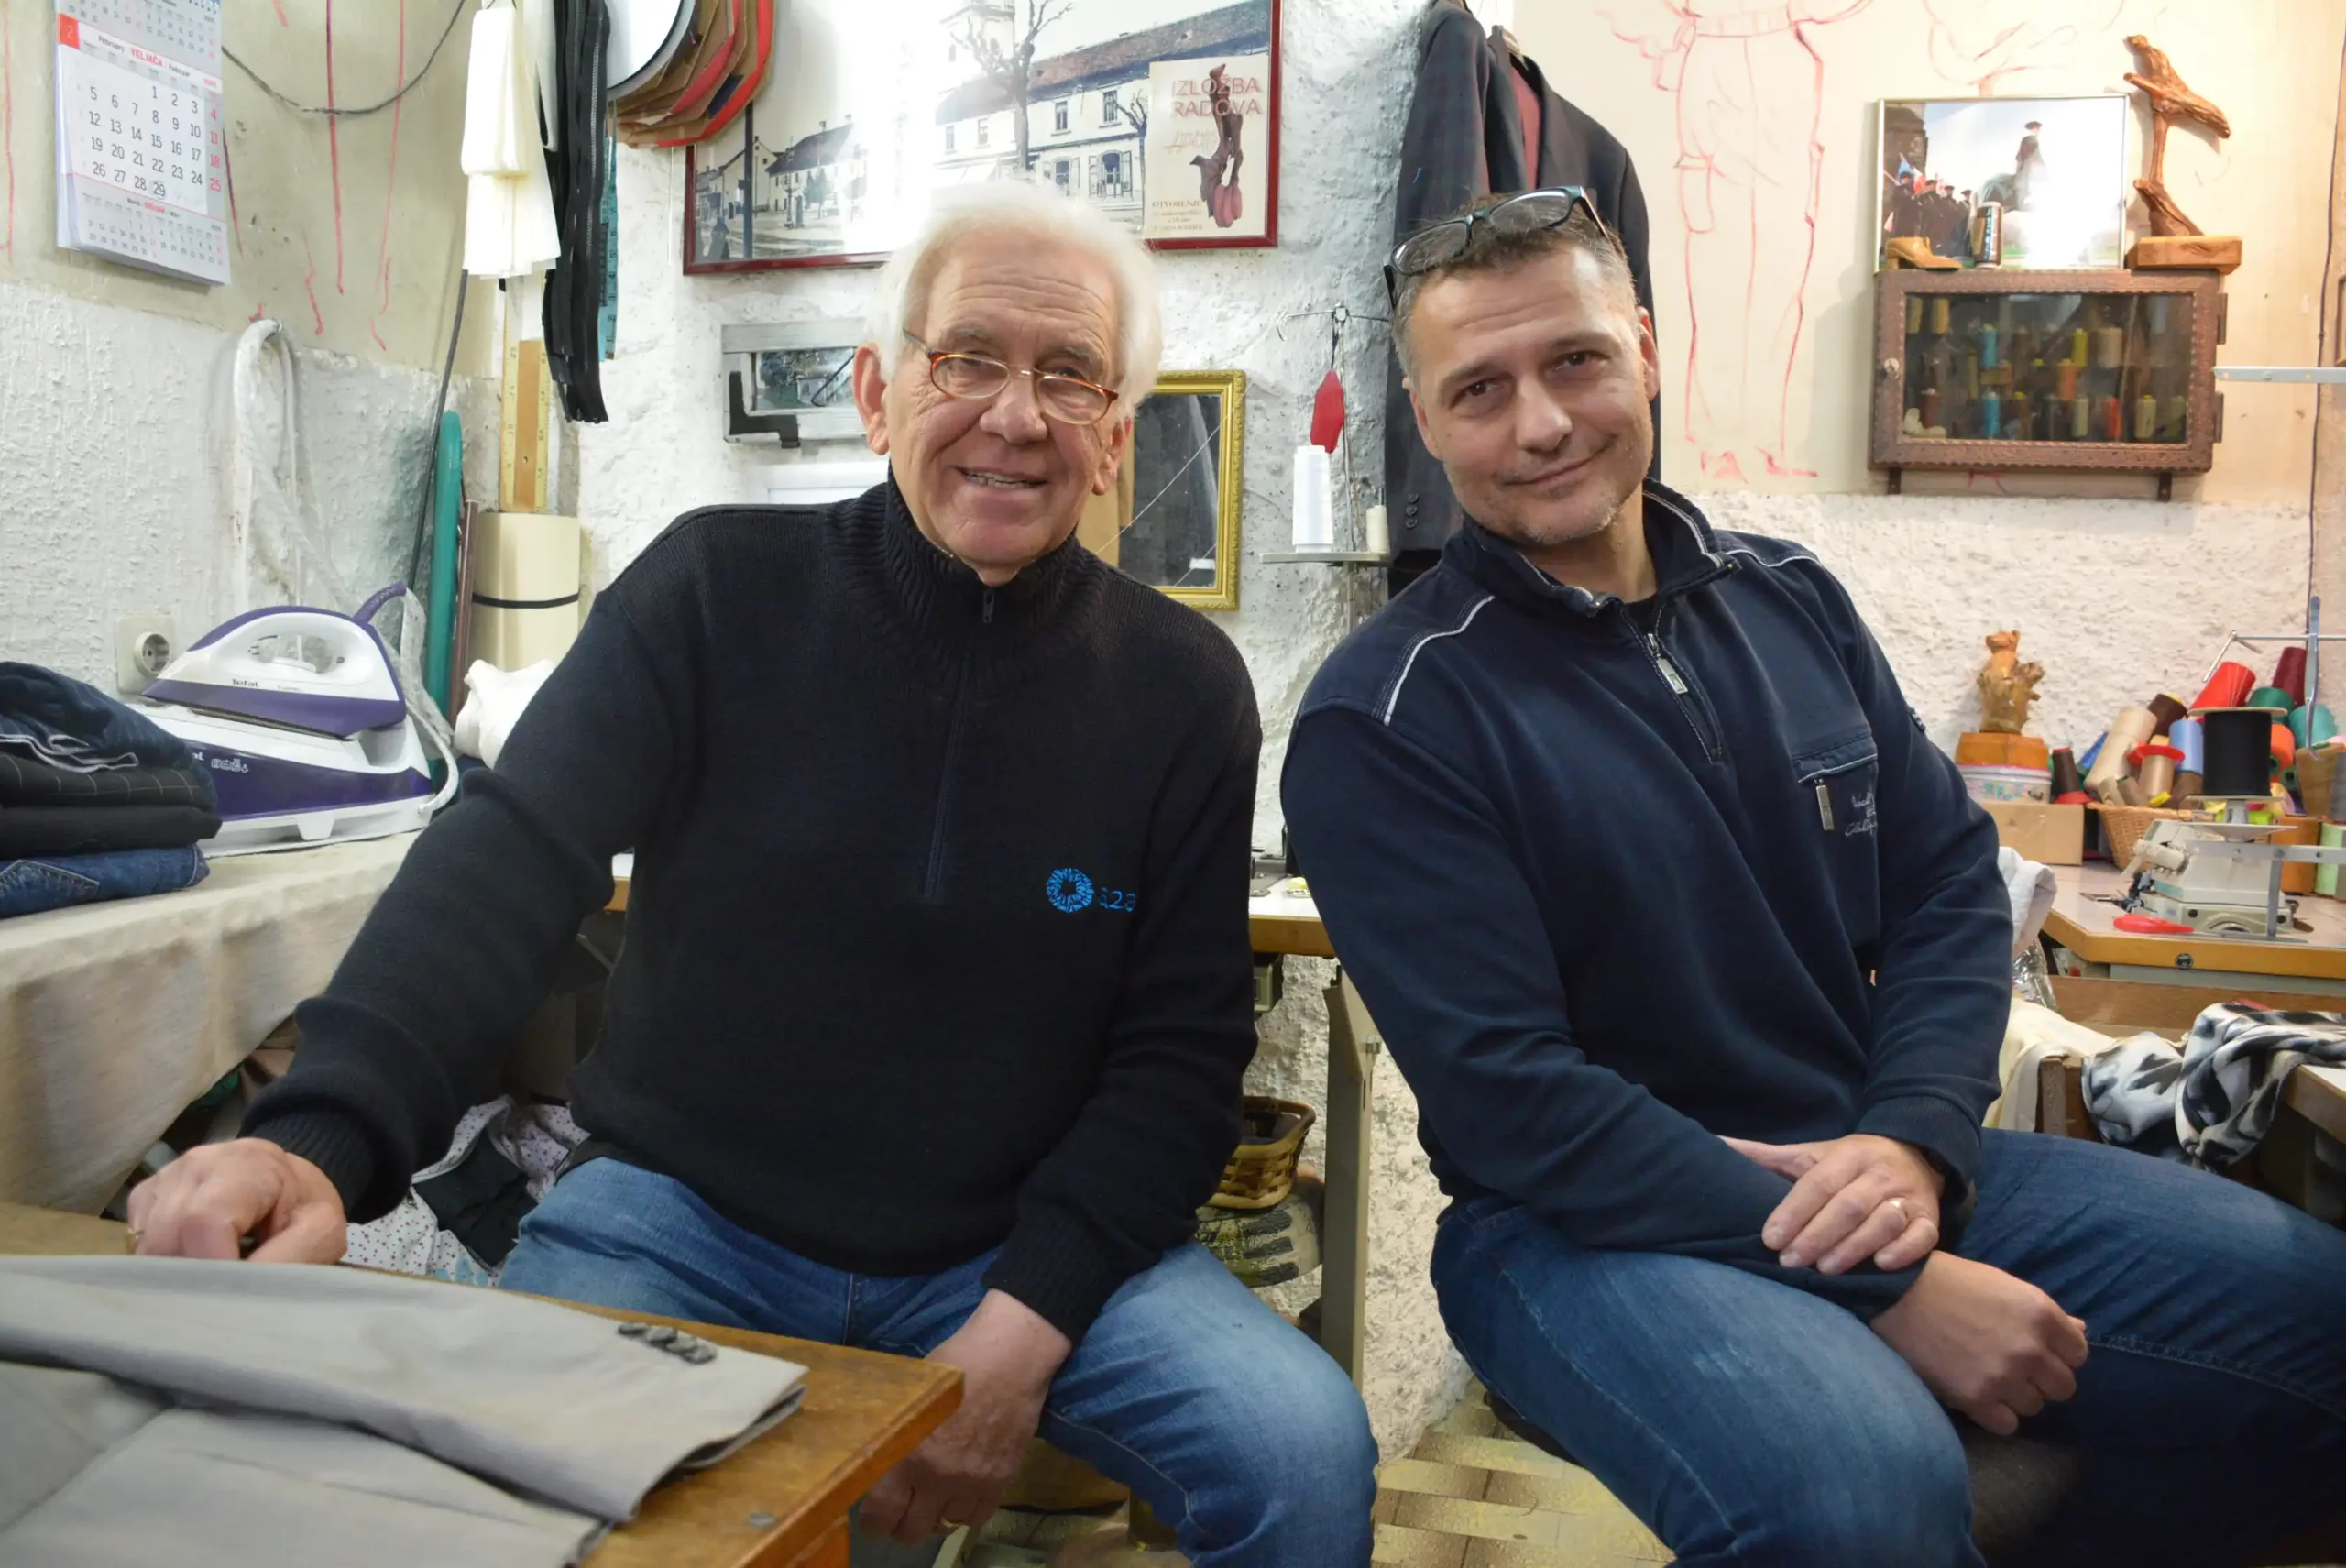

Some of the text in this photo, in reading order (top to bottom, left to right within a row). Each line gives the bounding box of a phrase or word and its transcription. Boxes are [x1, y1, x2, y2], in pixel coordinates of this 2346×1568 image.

[66, 25, 74, 39] 2
[131, 47, 163, 66] VELJAČA
[1172, 74, 1261, 97] IZLOŽBA
[91, 87, 218, 145] 5 6 7 8 9 10 11
[152, 86, 217, 120] 1 2 3 4
[1171, 99, 1262, 117] RADOVA
[89, 112, 220, 168] 12 13 14 15 16 17 18
[92, 137, 221, 192] 19 20 21 22 23 24 25
[93, 161, 166, 197] 26 27 28 29
[232, 679, 259, 688] Tefal
